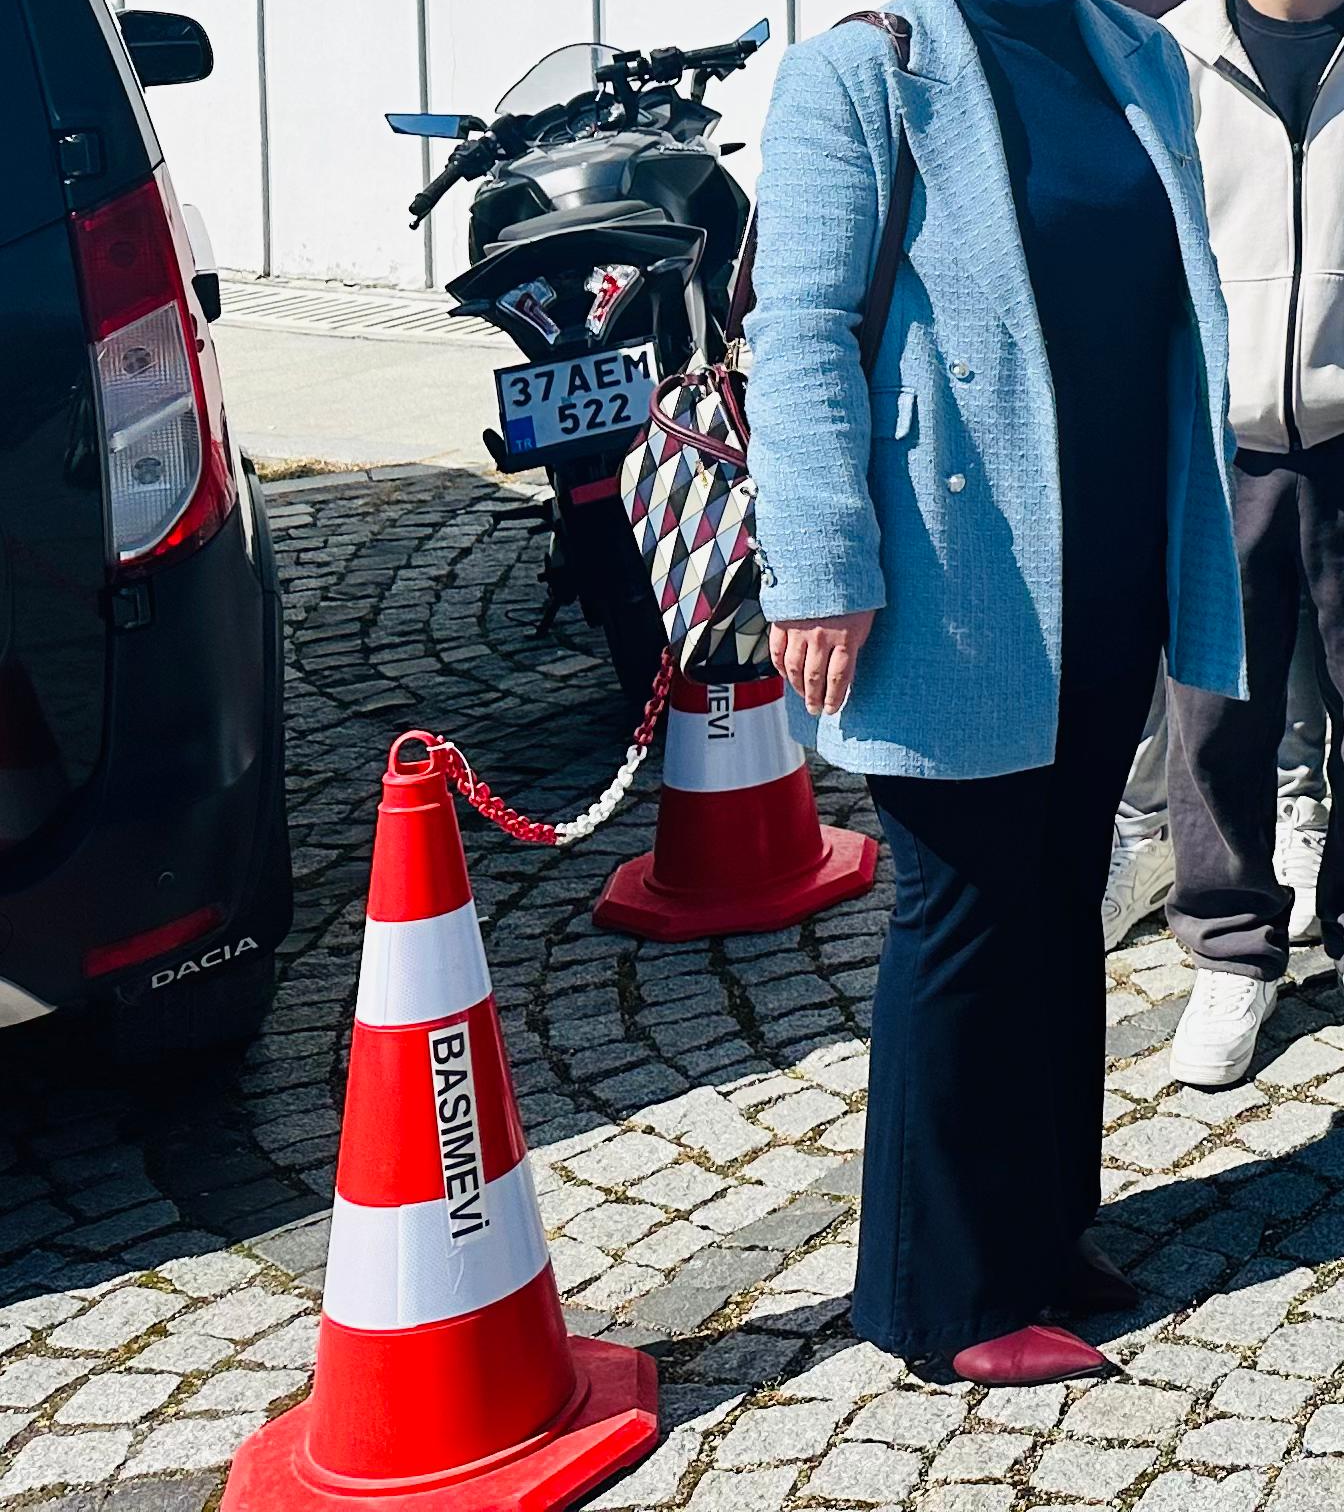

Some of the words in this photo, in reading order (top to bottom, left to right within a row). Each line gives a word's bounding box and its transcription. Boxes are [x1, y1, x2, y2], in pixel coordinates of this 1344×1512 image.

[510, 370, 555, 407] 37
[567, 350, 650, 396] AEM
[557, 392, 632, 435] 522
[515, 437, 535, 451] TR
[151, 936, 260, 989] DACIA
